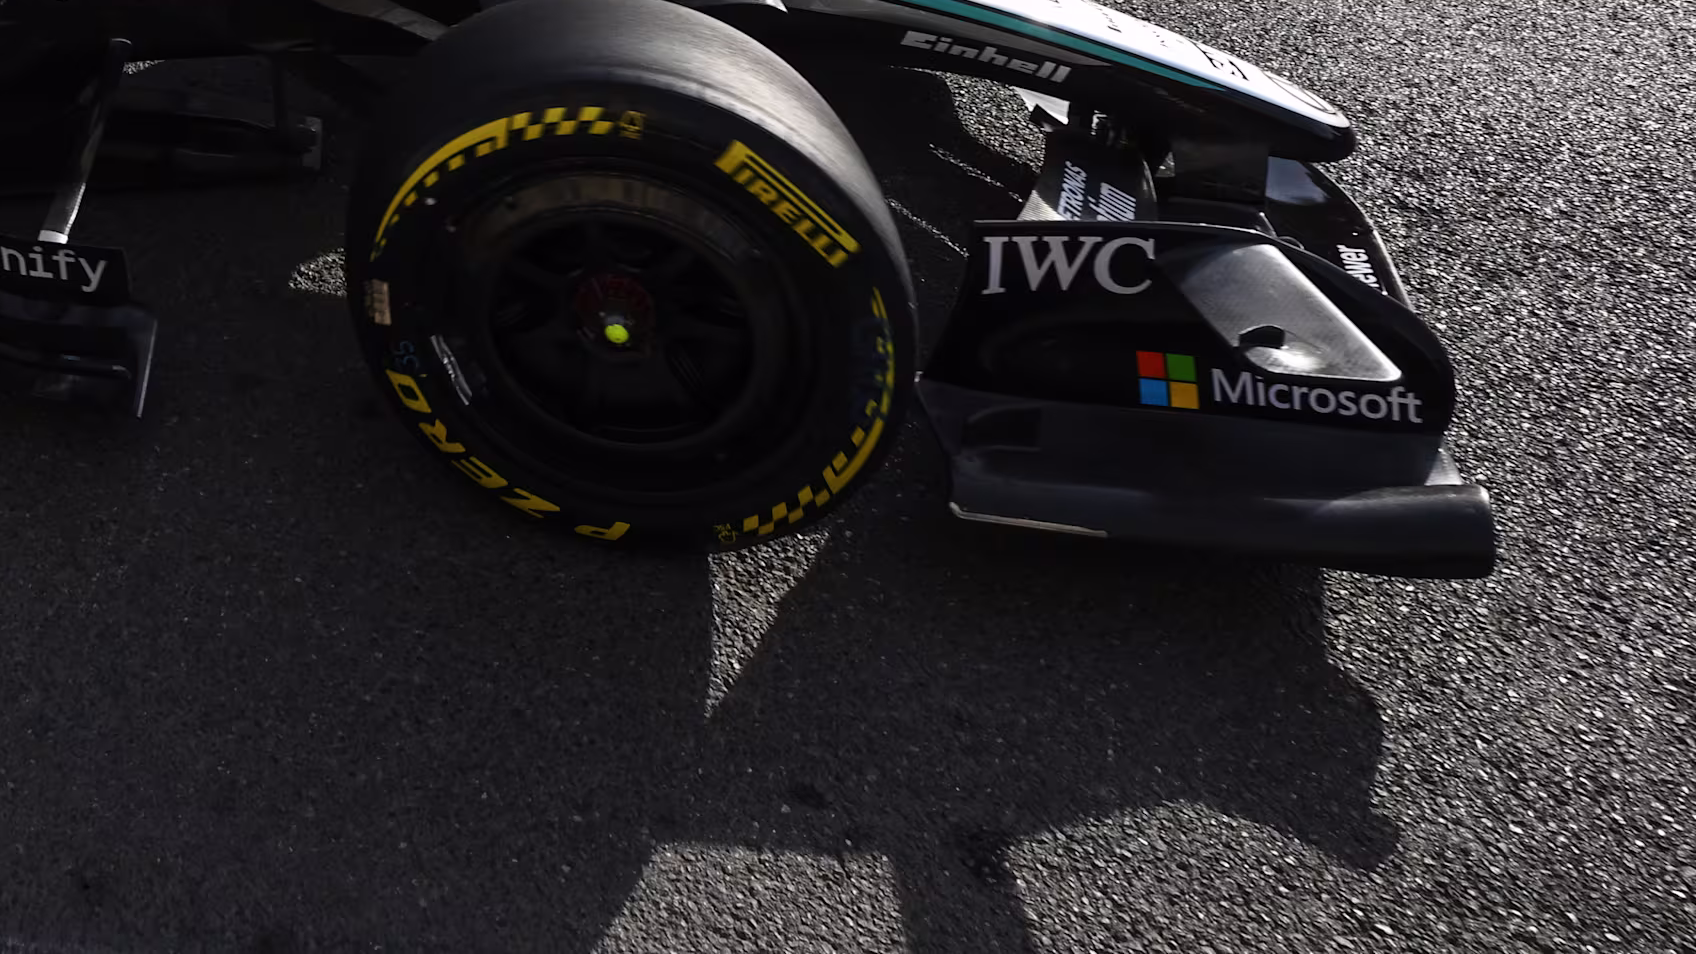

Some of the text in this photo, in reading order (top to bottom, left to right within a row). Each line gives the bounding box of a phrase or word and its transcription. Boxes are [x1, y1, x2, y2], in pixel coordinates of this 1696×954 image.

[900, 30, 1072, 83] Einhell
[713, 139, 862, 268] PIRELLI
[1057, 160, 1088, 221] ETRONAS
[981, 235, 1156, 294] IWC
[1210, 367, 1424, 424] Microsoft
[385, 368, 562, 519] ZERO
[573, 521, 631, 541] P
